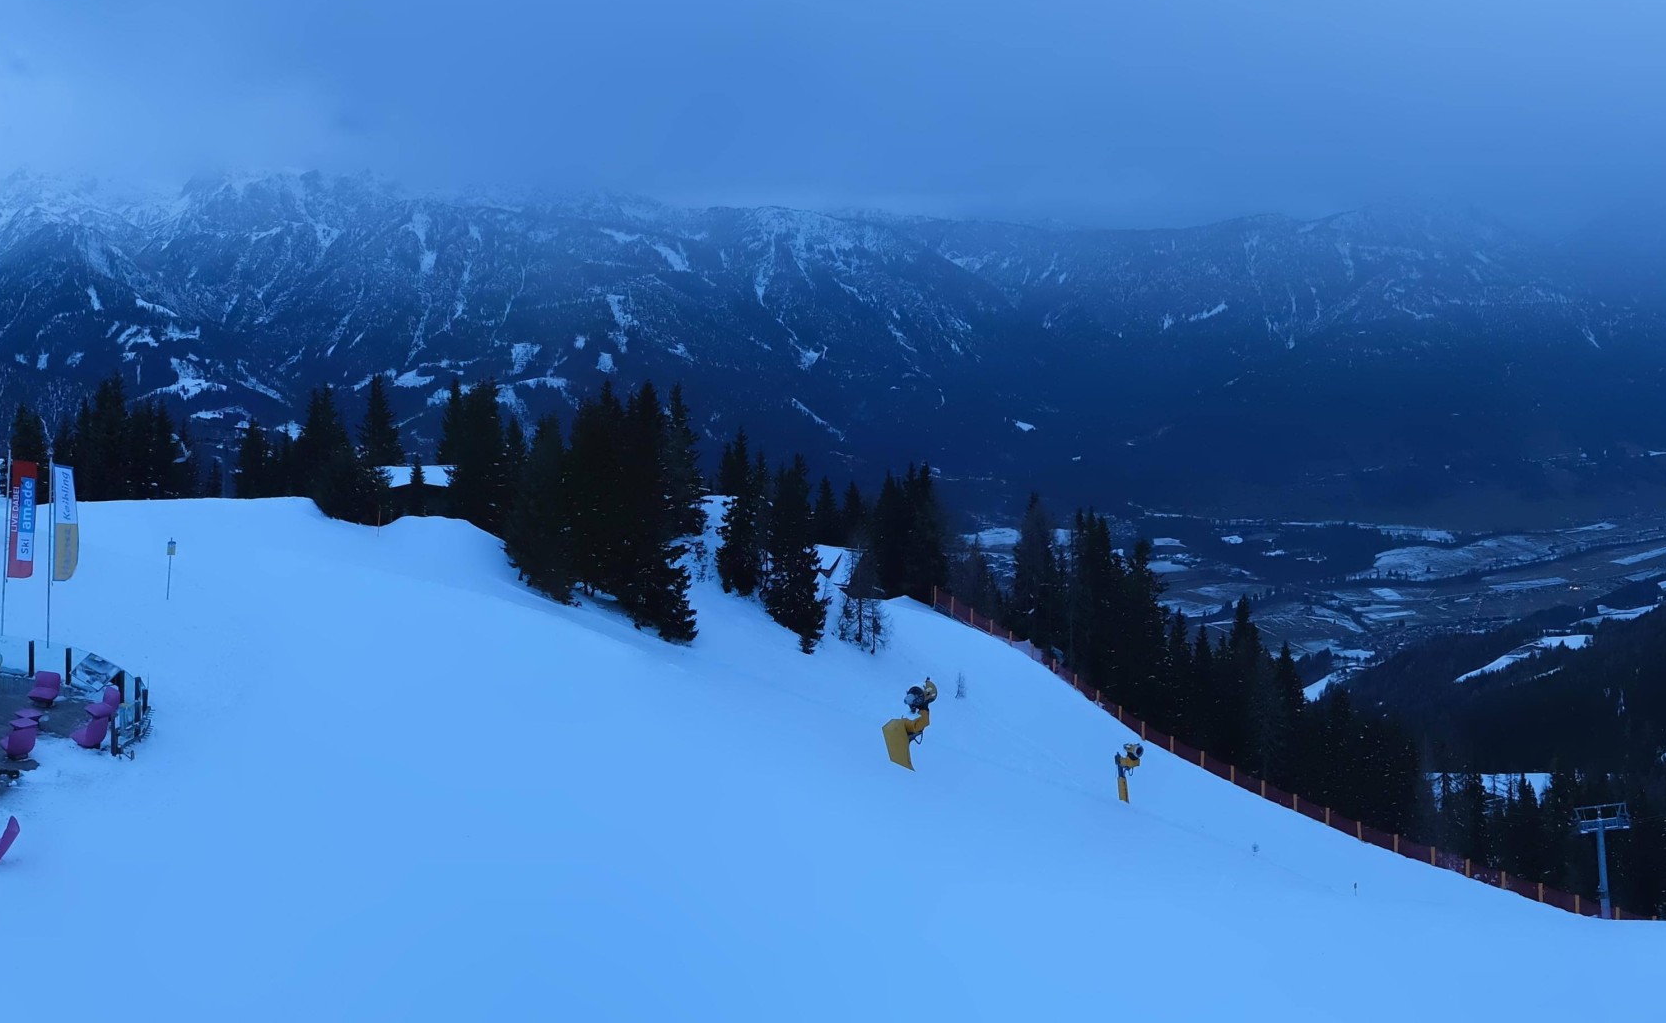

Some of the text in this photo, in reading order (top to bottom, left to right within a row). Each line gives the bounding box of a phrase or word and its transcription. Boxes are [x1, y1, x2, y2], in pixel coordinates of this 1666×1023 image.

[11, 486, 20, 533] LIVE DABEI
[62, 471, 71, 521] Kaibling
[20, 539, 30, 555] Ski
